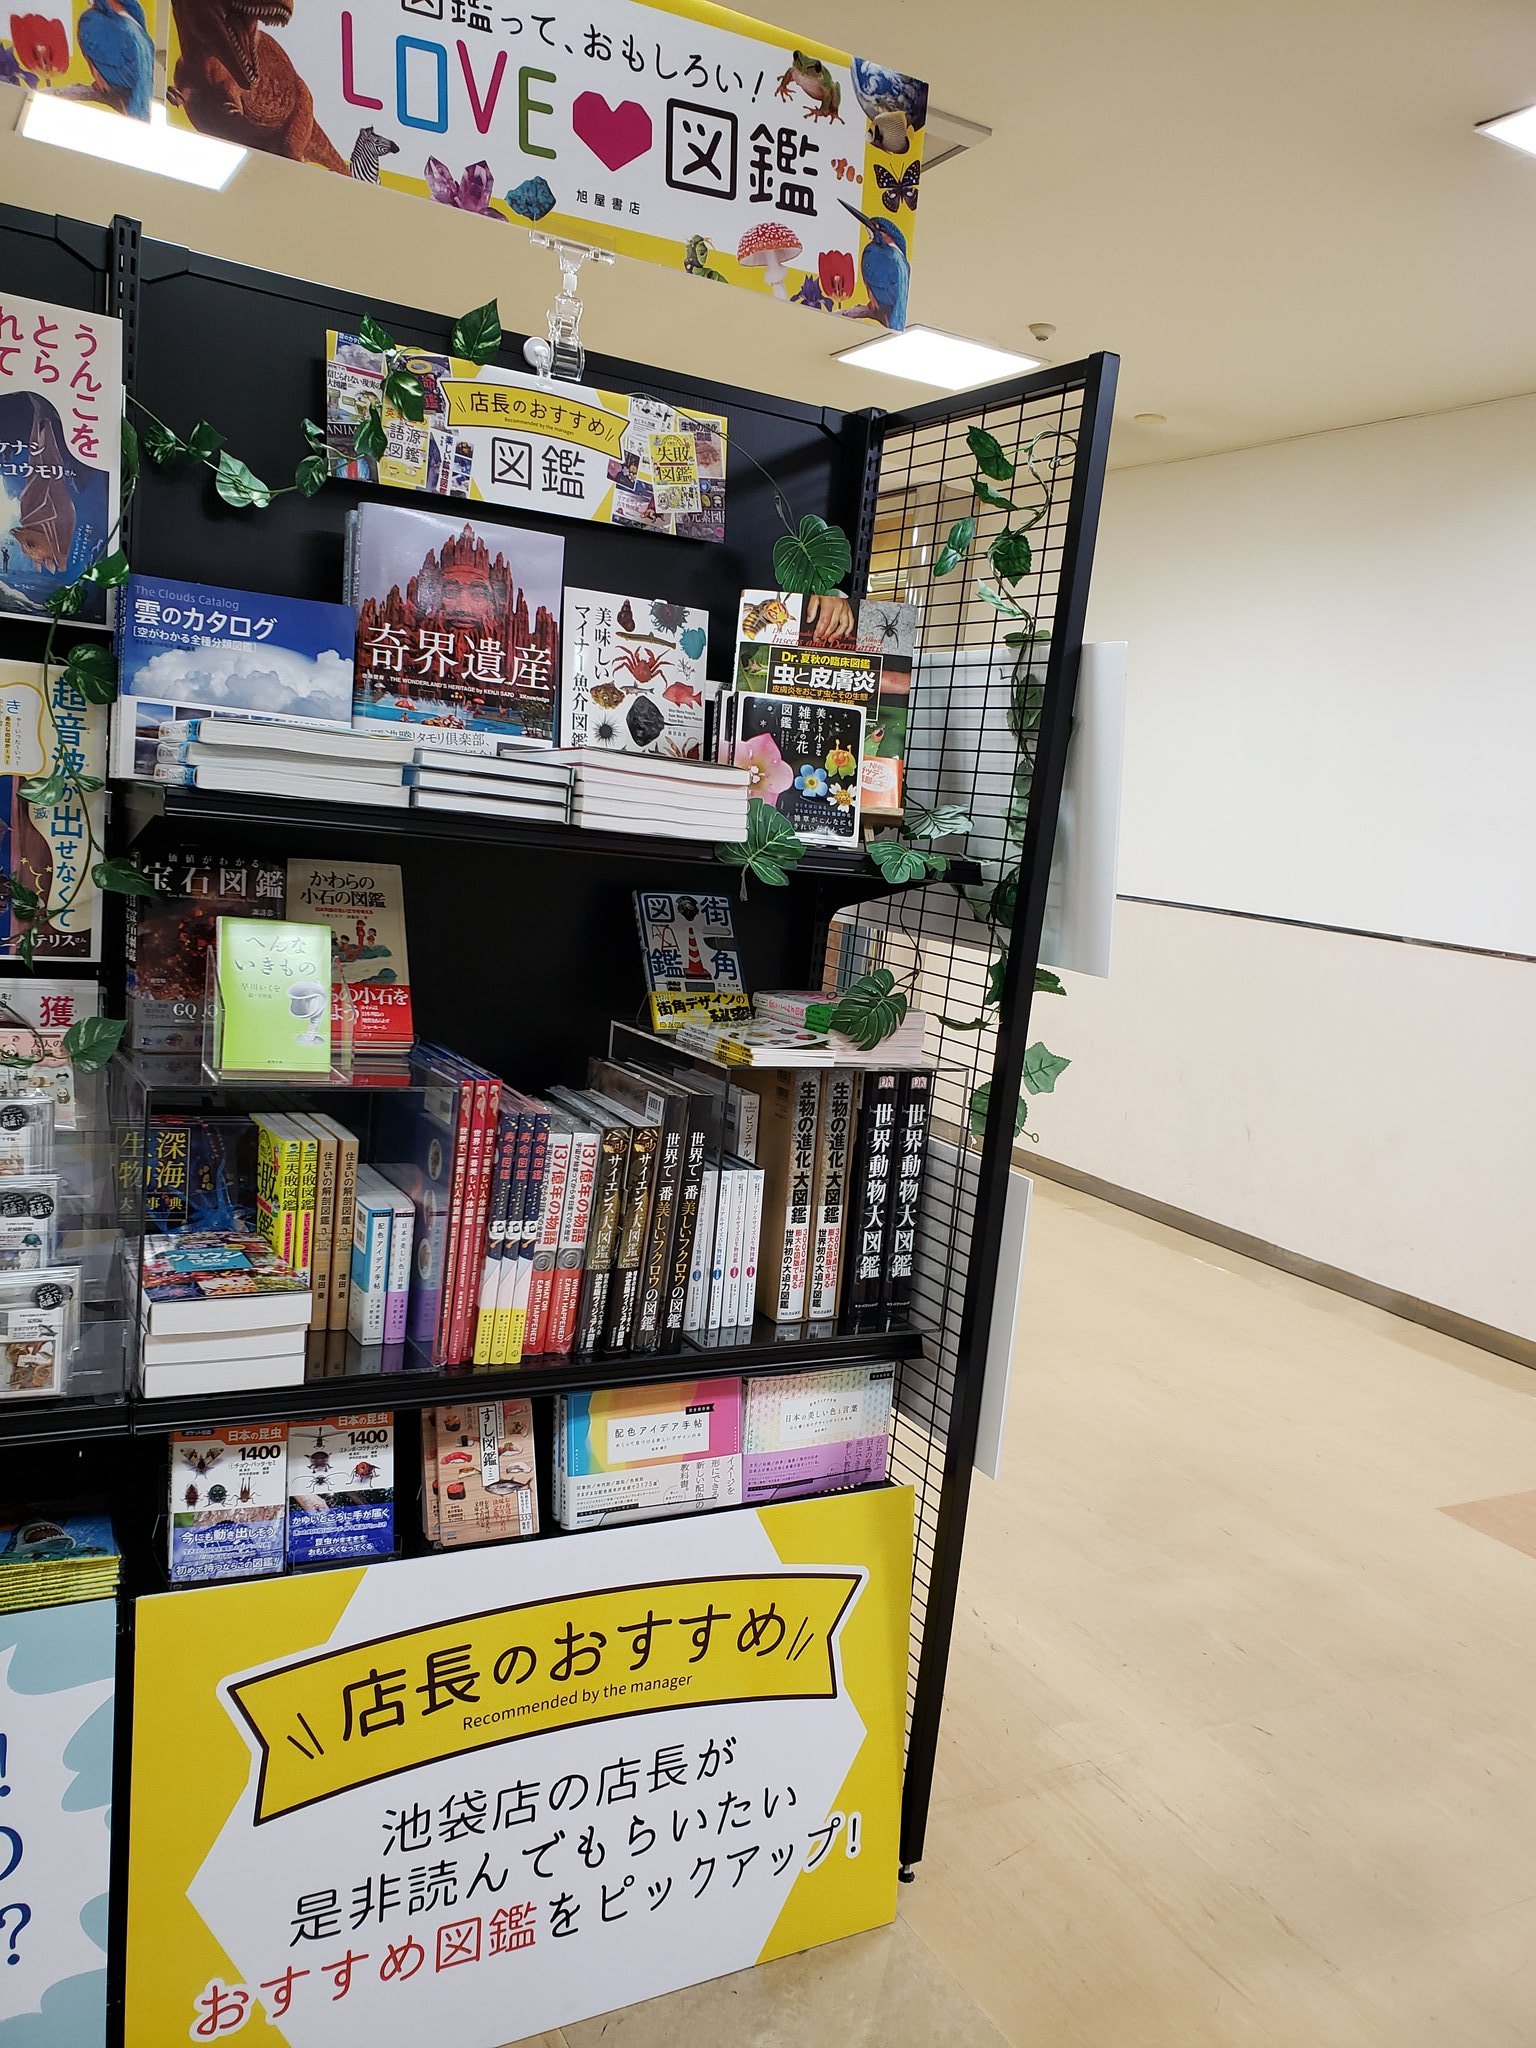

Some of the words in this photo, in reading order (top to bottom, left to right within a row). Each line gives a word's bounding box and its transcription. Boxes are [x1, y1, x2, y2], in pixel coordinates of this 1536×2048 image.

[340, 11, 557, 160] LOVE
[664, 97, 820, 217] 図鑑
[576, 187, 641, 215] 旭屋書店
[33, 315, 60, 384] とら
[69, 323, 102, 459] うんこを
[470, 390, 605, 437] 店長のおすすめ
[491, 436, 586, 499] 図鑑
[657, 446, 690, 462] 失敗
[133, 598, 279, 641] 雲のカタログ
[134, 584, 156, 597] The
[158, 588, 196, 604] Clouds
[198, 595, 240, 612] Catalog
[363, 622, 552, 692] 奇界遺産
[594, 606, 612, 681] 美味しい
[772, 663, 876, 694] 虫と皮膚炎
[780, 703, 793, 729] 図鑑
[796, 705, 812, 755] 雑草の花
[814, 707, 827, 757] 美しき小さな
[142, 861, 285, 899] 宝石図鑑
[168, 852, 260, 869] 価値がわかる
[309, 870, 375, 890] かわらの
[300, 887, 387, 909] 小石の図鑑
[234, 956, 317, 977] いきもの
[246, 935, 307, 955] へんな
[39, 995, 75, 1028] 獲
[172, 1002, 197, 1020] GQ
[656, 993, 746, 1017] 街角デザインの
[880, 1077, 893, 1087] DK
[913, 1077, 926, 1087] DK
[156, 1131, 187, 1190] 深海
[452, 1126, 469, 1224] 世界で一番美しい人体図鑑
[464, 1128, 482, 1225] 世界で一番美しい人体図鑑
[476, 1128, 494, 1224] 世界で一番美しい人体図鑑
[790, 1081, 818, 1225] 生物の進化大図鑑
[823, 1081, 851, 1225] 生物の進化大図鑑
[282, 1163, 300, 1212] 失敗図鑑
[300, 1163, 317, 1212] 失敗図鑑
[320, 1151, 334, 1226] 住まいの解剖図鑑
[341, 1151, 356, 1226] 住まいの解剖図鑑
[543, 1143, 569, 1246] 137億年の物語
[571, 1142, 597, 1243] 137億年の物語
[596, 1154, 623, 1259] サイエンス大図鑑
[625, 1153, 652, 1258] サイエンス大図鑑
[860, 1103, 894, 1280] 世界動物大図鑑
[891, 1103, 926, 1279] 世界動物大図鑑
[640, 1132, 681, 1332] 世界で一番美しいフクロウの図鑑
[666, 1131, 706, 1330] 世界で一番美しいフクロウの図鑑
[373, 1222, 385, 1290] 配色アイデア手帖
[780, 1228, 795, 1309] 世界初の大迫力図鑑
[812, 1228, 827, 1308] 世界初の大迫力図鑑
[534, 1279, 544, 1303] EARTH
[541, 1300, 549, 1311] ON
[543, 1280, 551, 1300] WHAT
[562, 1278, 572, 1301] EARTH
[569, 1298, 577, 1309] ON
[570, 1278, 579, 1298] WHAT
[529, 1304, 541, 1346] HAPPENED?
[227, 1426, 283, 1442] 日本の昆虫
[337, 1412, 389, 1427] 日本の昆虫
[347, 1429, 388, 1446] 1400
[614, 1419, 703, 1439] 配色アイデア手帖
[238, 1445, 281, 1461] 1400
[726, 1456, 736, 1495] イメージを
[292, 1508, 390, 1526] かゆいところに手が届く
[341, 1602, 788, 1743] 店長のおすすめ
[461, 1688, 579, 1731] Recommended
[580, 1684, 601, 1706] by
[602, 1678, 626, 1700] the
[628, 1671, 694, 1698] manager
[380, 1736, 739, 1858] 池袋店の店長が
[289, 1783, 799, 1948] 是非読んでもらいたい
